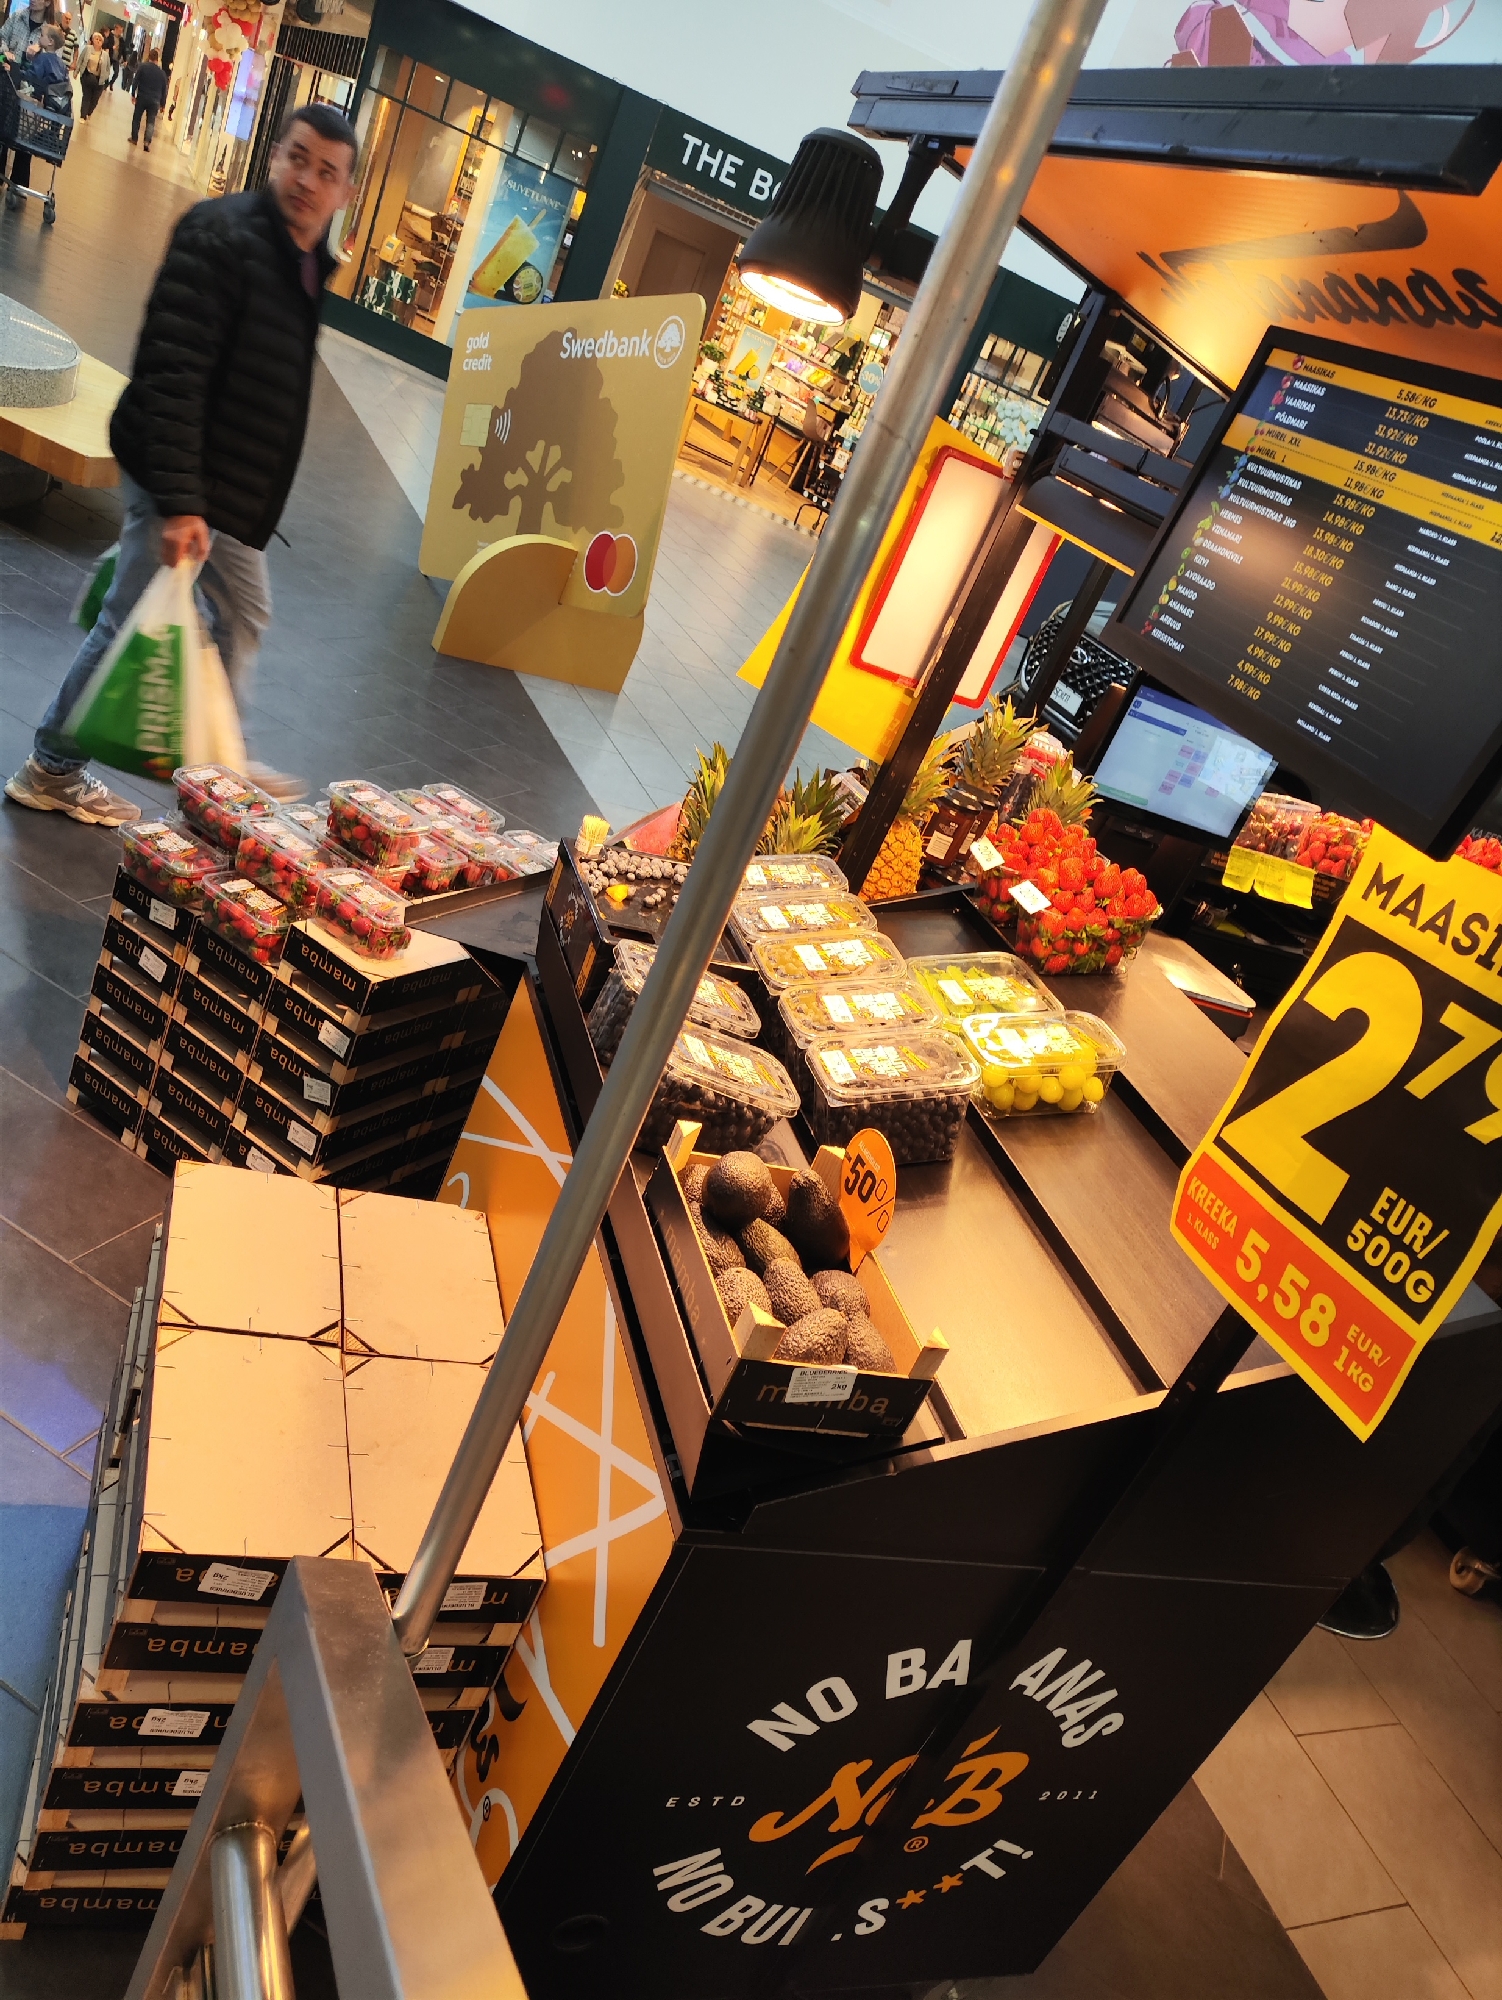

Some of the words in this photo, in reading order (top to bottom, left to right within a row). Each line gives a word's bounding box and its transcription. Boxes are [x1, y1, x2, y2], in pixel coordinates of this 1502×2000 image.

[682, 133, 744, 189] THE
[507, 179, 561, 211] SUVETUNNE
[463, 354, 493, 371] credit
[466, 332, 490, 353] gold
[559, 328, 653, 359] Swedbank
[1361, 862, 1502, 974] MAASI
[207, 938, 259, 985] mamba
[302, 942, 357, 992] mamba
[105, 980, 155, 1025] mamba
[193, 987, 245, 1035] mamba
[95, 1027, 144, 1072] mamba
[179, 1036, 230, 1082] mamba
[84, 1071, 131, 1115] mamba
[168, 1082, 218, 1129] mamba
[843, 1150, 895, 1234] -50%
[1186, 1176, 1239, 1239] KREEKA
[1194, 1219, 1220, 1251] KLASS
[1370, 1186, 1449, 1259] EUR/
[1346, 1218, 1436, 1304] 500G
[1235, 1227, 1337, 1348] 5,58
[1346, 1323, 1391, 1368] EUR/
[831, 1383, 848, 1391] 2kg
[1333, 1345, 1374, 1393] 1KG
[147, 1637, 258, 1658] amba
[746, 1676, 858, 1752] NO
[885, 1639, 1125, 1749] BAANAS
[665, 1795, 746, 1808] ESTD
[1038, 1790, 1099, 1801] 2011
[652, 1847, 734, 1913] NO
